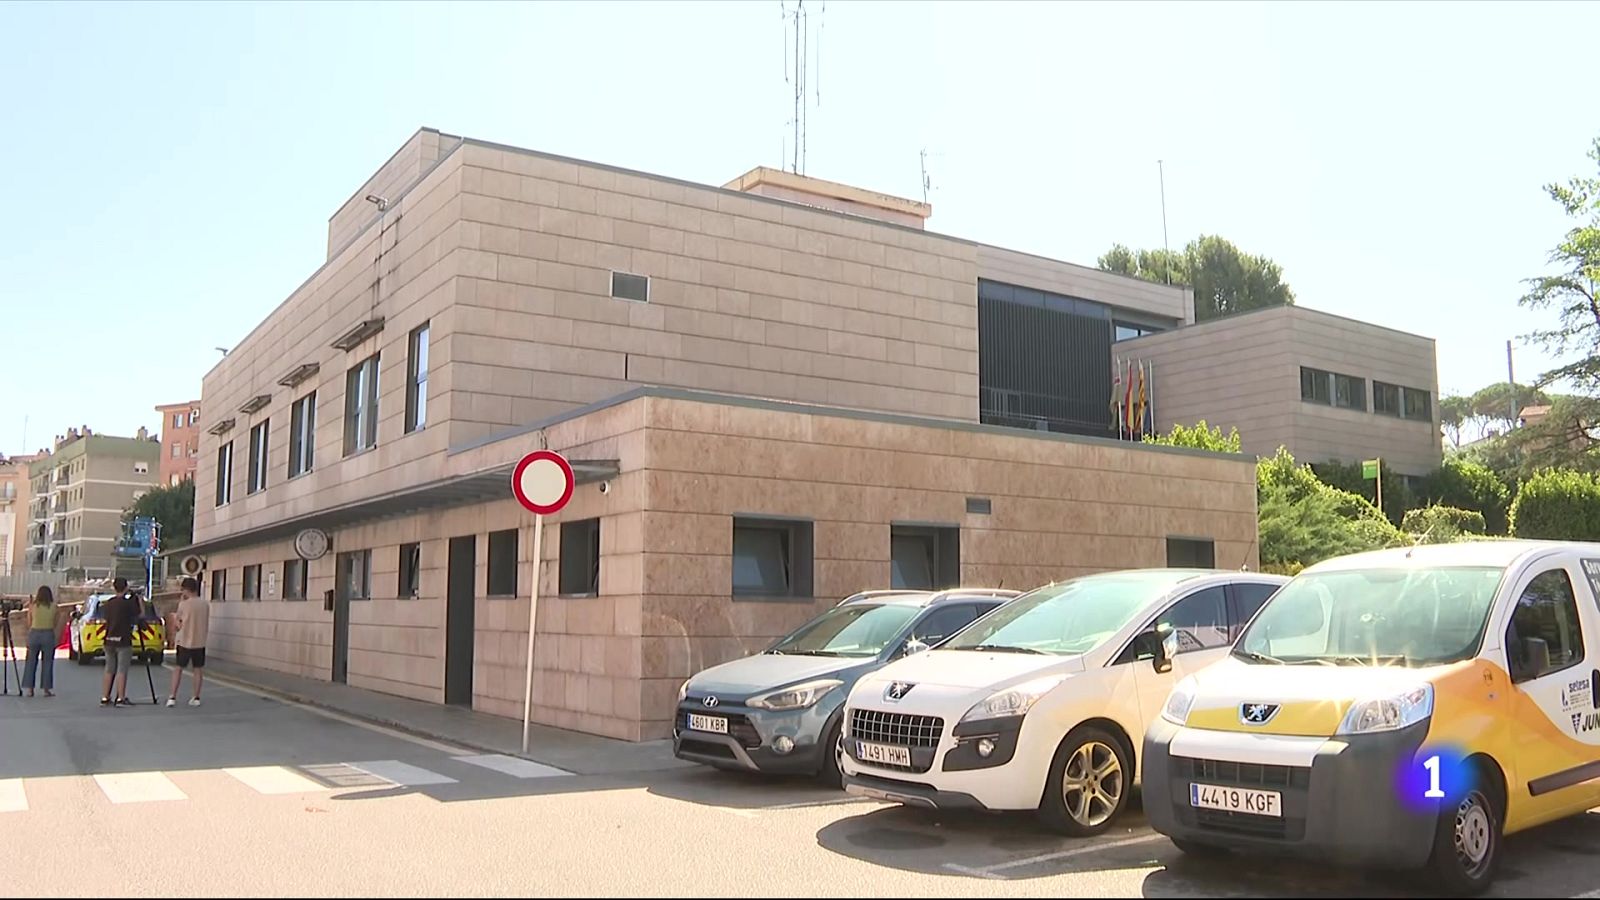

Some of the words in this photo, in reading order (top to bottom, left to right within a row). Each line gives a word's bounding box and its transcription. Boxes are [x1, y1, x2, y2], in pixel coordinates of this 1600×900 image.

[691, 715, 708, 729] 4601
[710, 718, 726, 731] KBR
[863, 744, 885, 761] 1491
[888, 747, 908, 764] HMH
[1201, 787, 1240, 808] 4419
[1245, 792, 1276, 812] KGF
